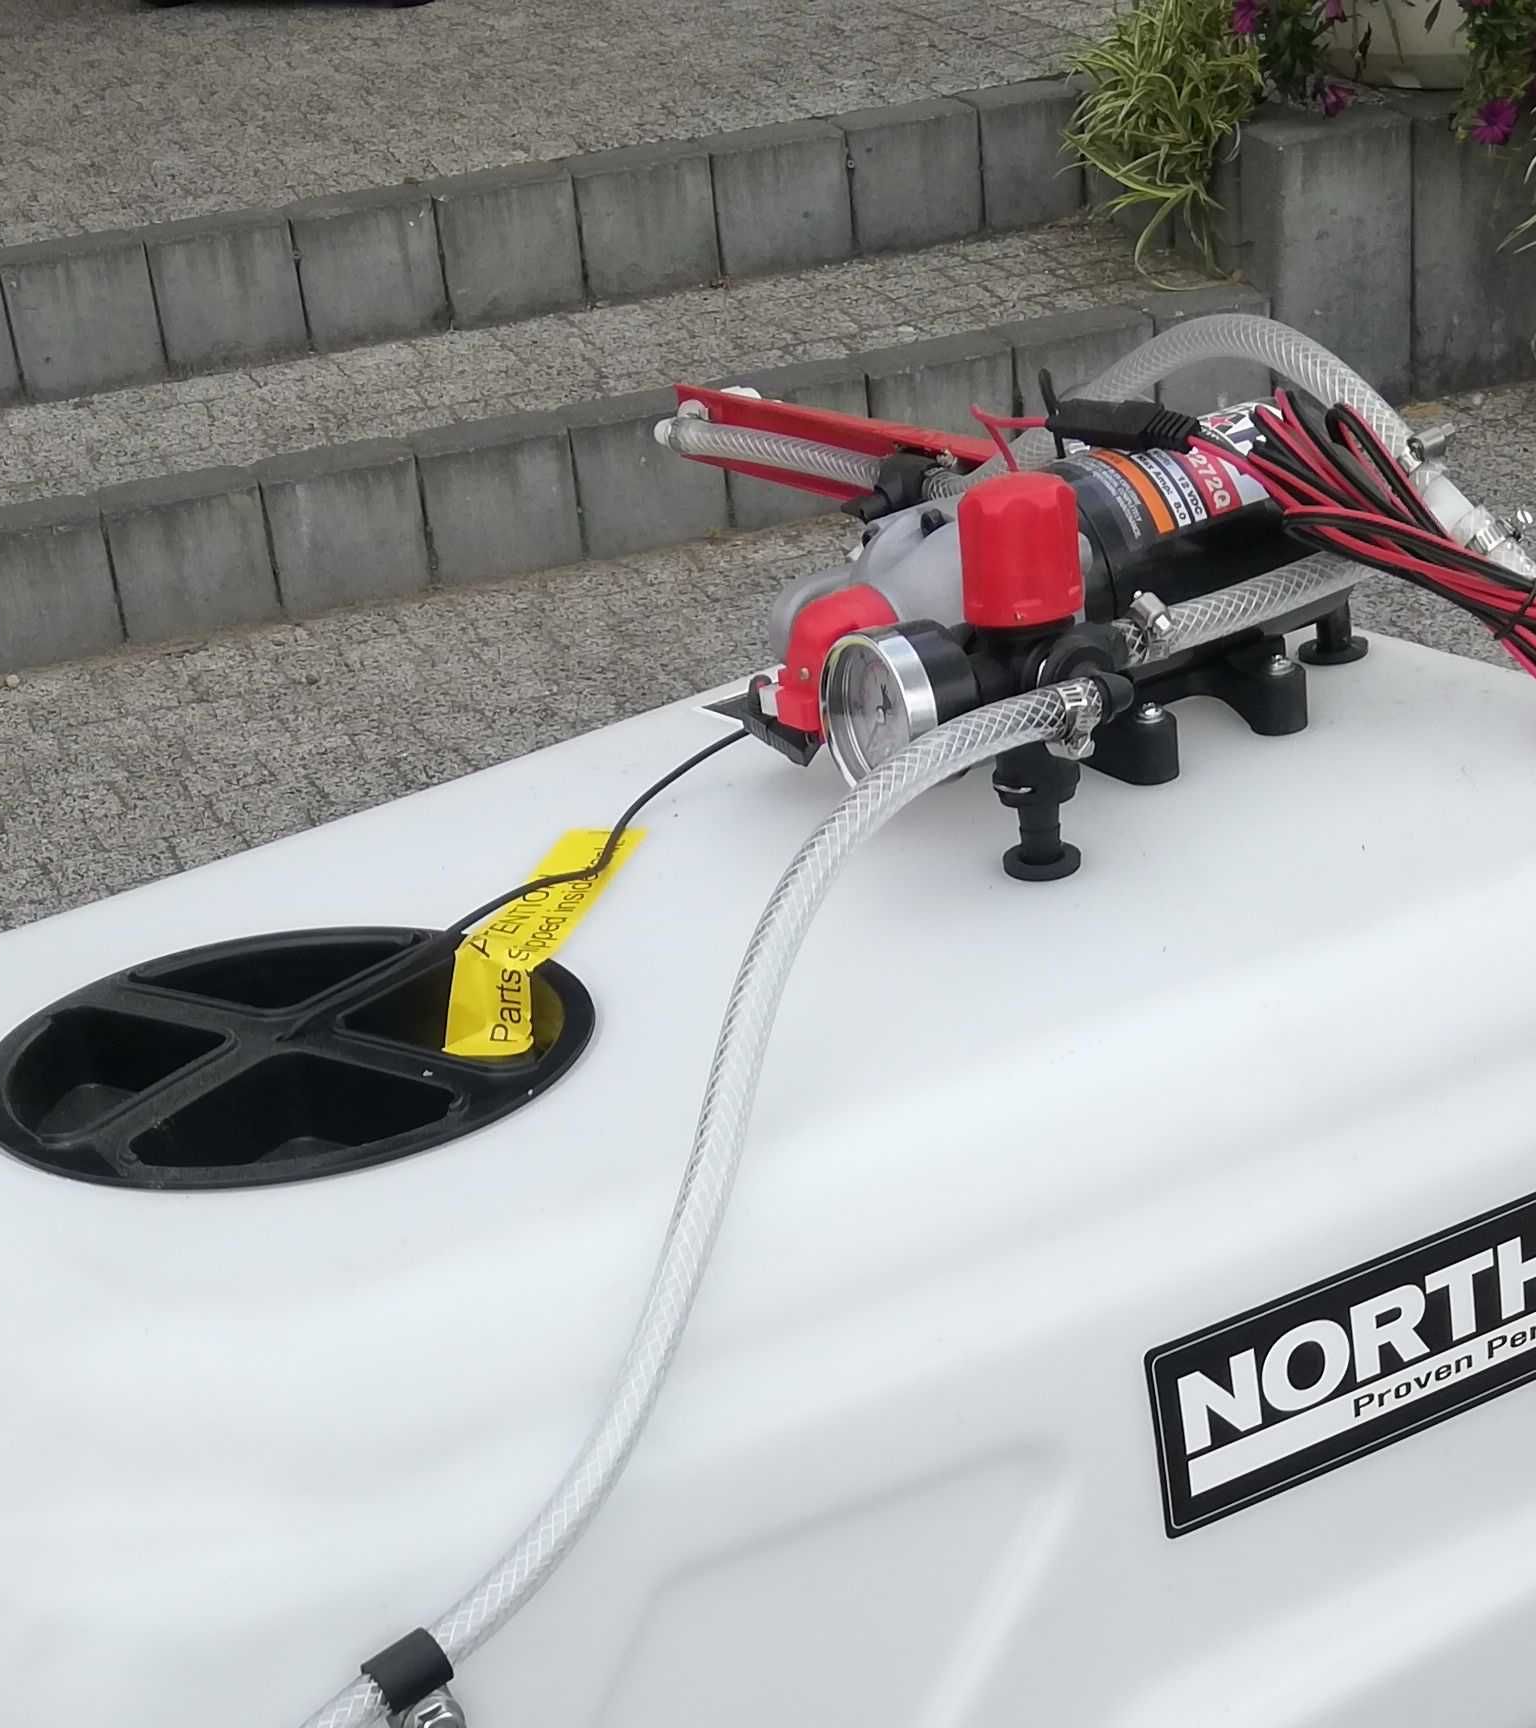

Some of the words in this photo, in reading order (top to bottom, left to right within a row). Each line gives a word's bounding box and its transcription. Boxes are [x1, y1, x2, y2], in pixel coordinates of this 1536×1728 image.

[1173, 501, 1187, 522] 8.0
[1177, 473, 1191, 490] 12
[1186, 485, 1205, 517] VDC
[489, 967, 522, 1042] Parts
[1353, 1353, 1473, 1418] Proven
